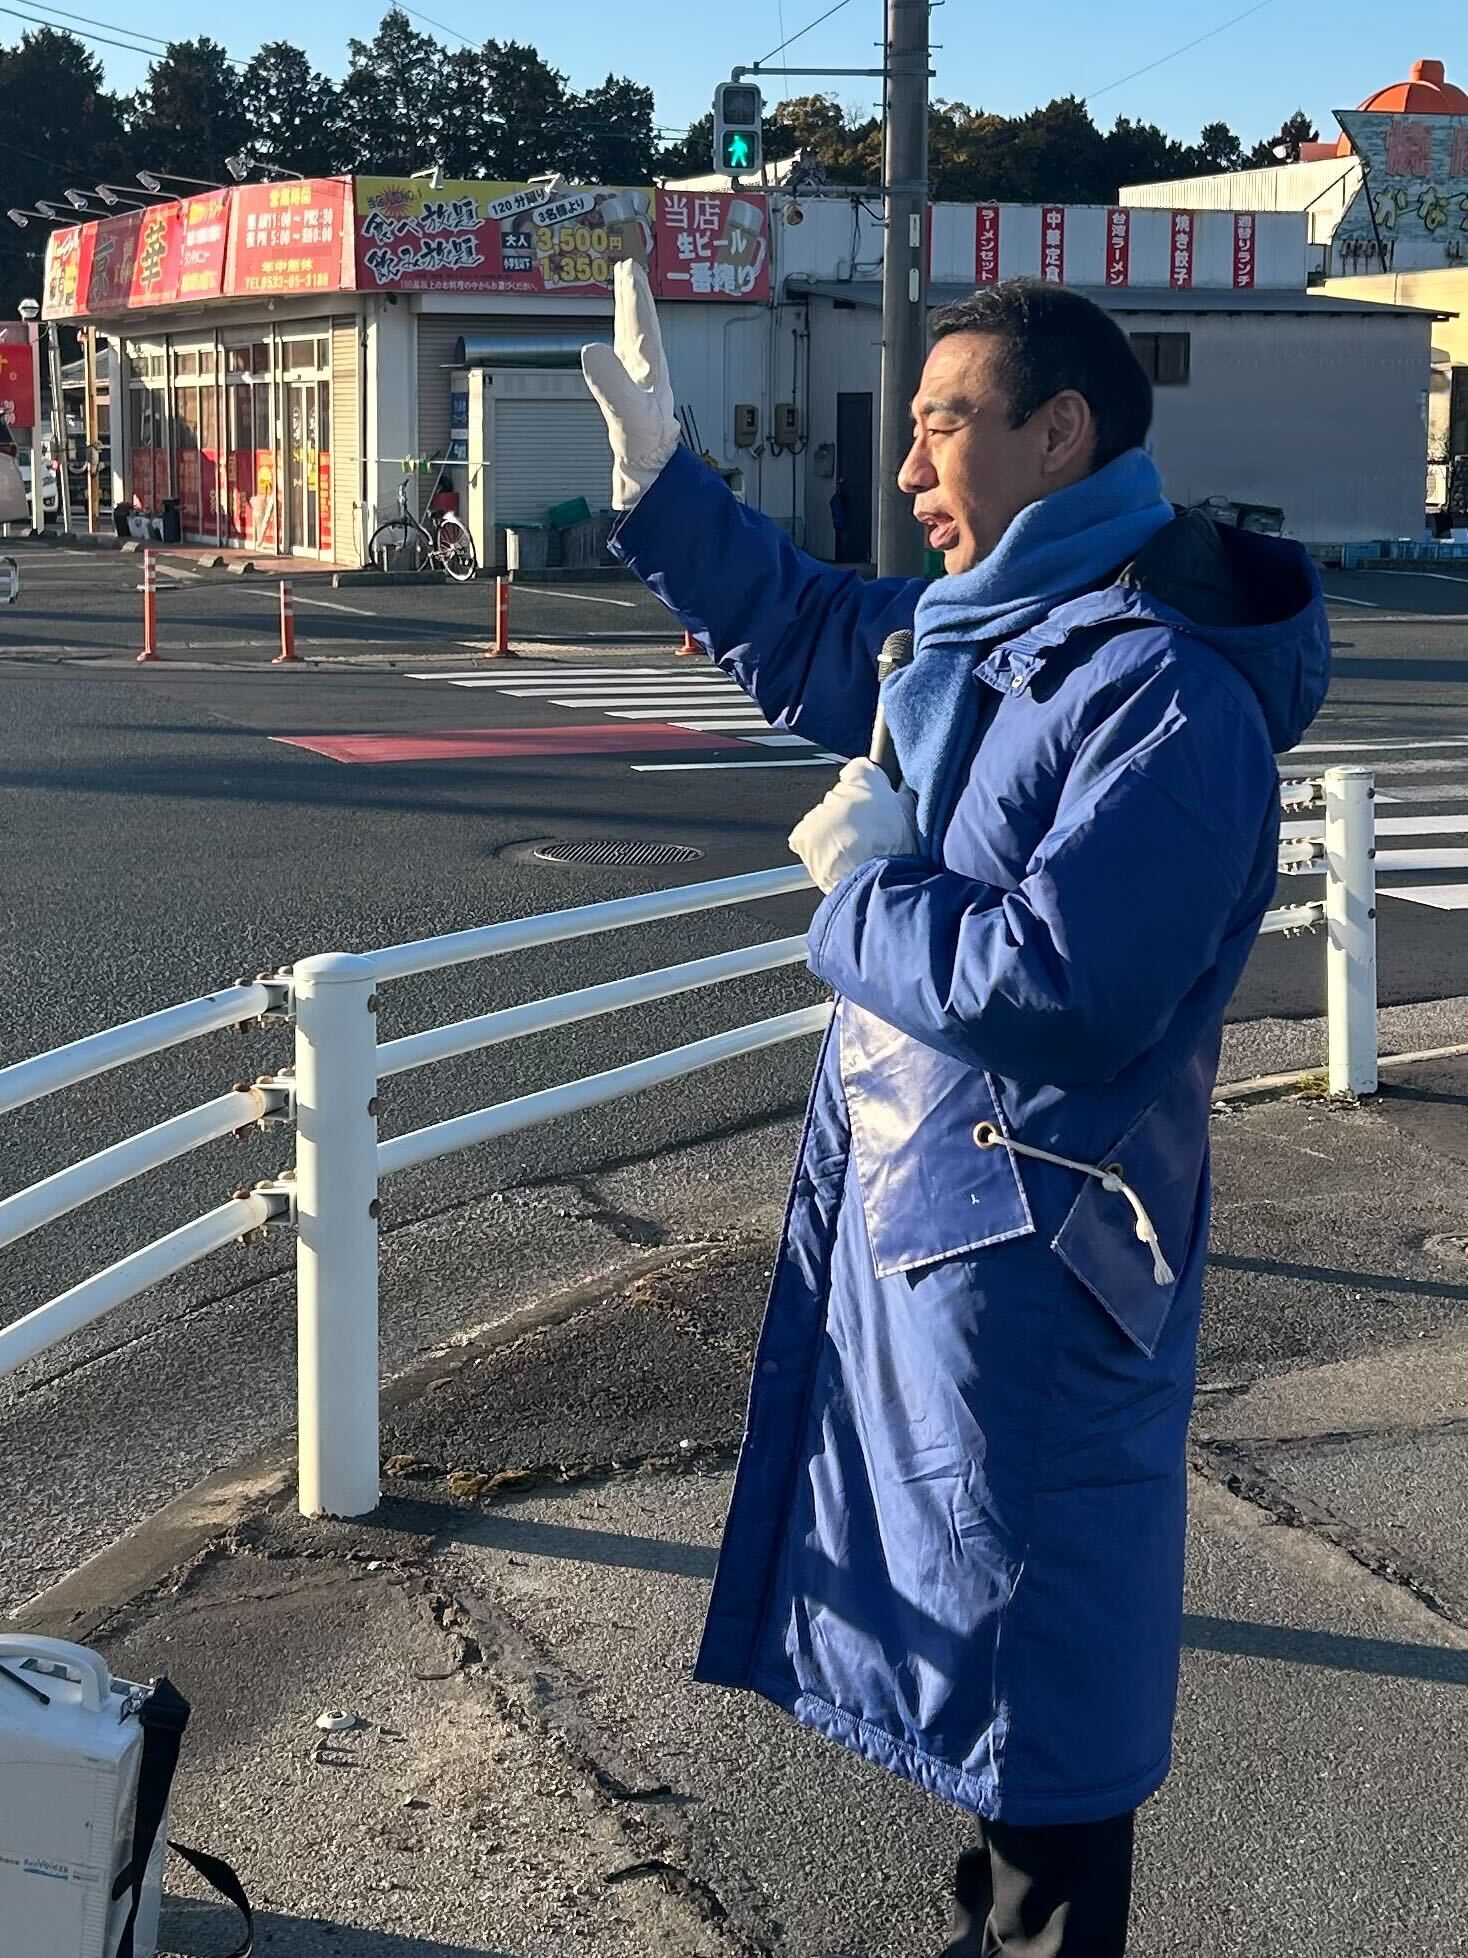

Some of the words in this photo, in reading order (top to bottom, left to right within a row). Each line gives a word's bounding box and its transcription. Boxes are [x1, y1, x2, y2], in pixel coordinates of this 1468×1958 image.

[363, 199, 484, 244] 食べ放題
[538, 197, 585, 223] 3名様より
[664, 194, 721, 230] 当店
[366, 236, 484, 283] 飲み放題
[505, 234, 528, 247] 大人
[536, 226, 623, 254] 3,500円
[677, 229, 747, 260] 生ビール
[980, 209, 995, 281] ラーメンセット
[1046, 210, 1062, 283] 中華定食
[1110, 212, 1127, 285] 台湾ラーメン
[1174, 214, 1190, 285] 焼き餃子
[1237, 215, 1252, 286] 週替りランチ
[261, 257, 313, 272] 年中無休
[666, 262, 756, 294] 一番搾り
